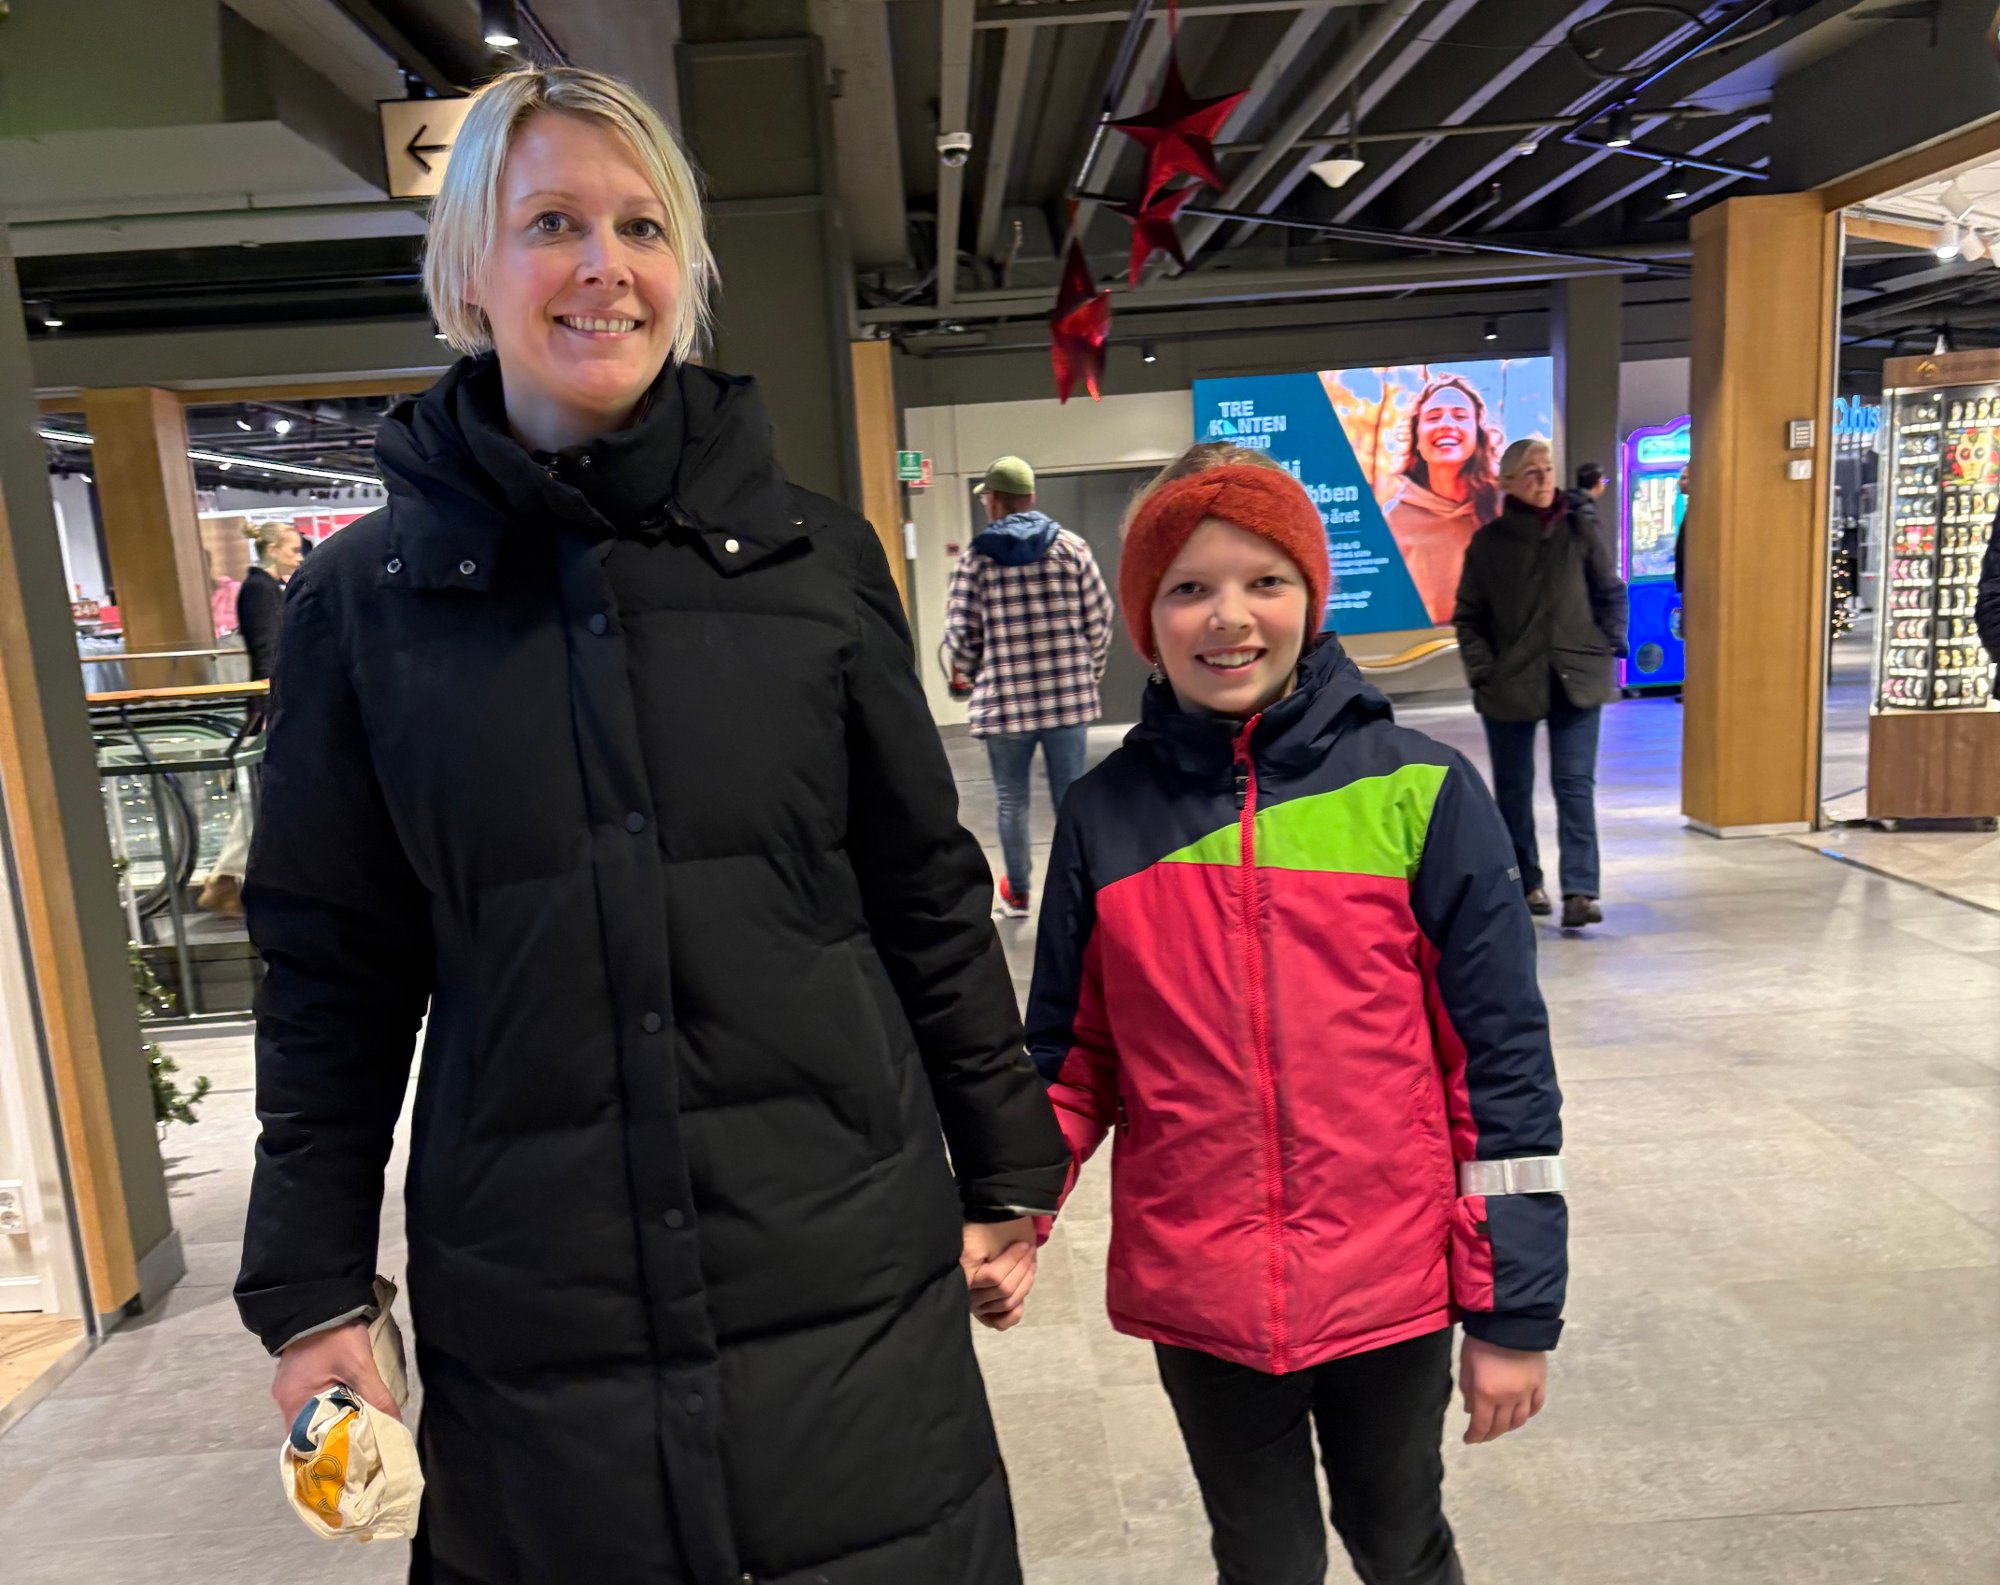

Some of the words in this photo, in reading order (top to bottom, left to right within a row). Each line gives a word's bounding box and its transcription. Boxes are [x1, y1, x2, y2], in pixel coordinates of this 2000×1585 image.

[1217, 400, 1254, 418] TRE
[1209, 415, 1287, 436] KANTEN
[1304, 483, 1359, 506] bben
[1330, 508, 1361, 524] året
